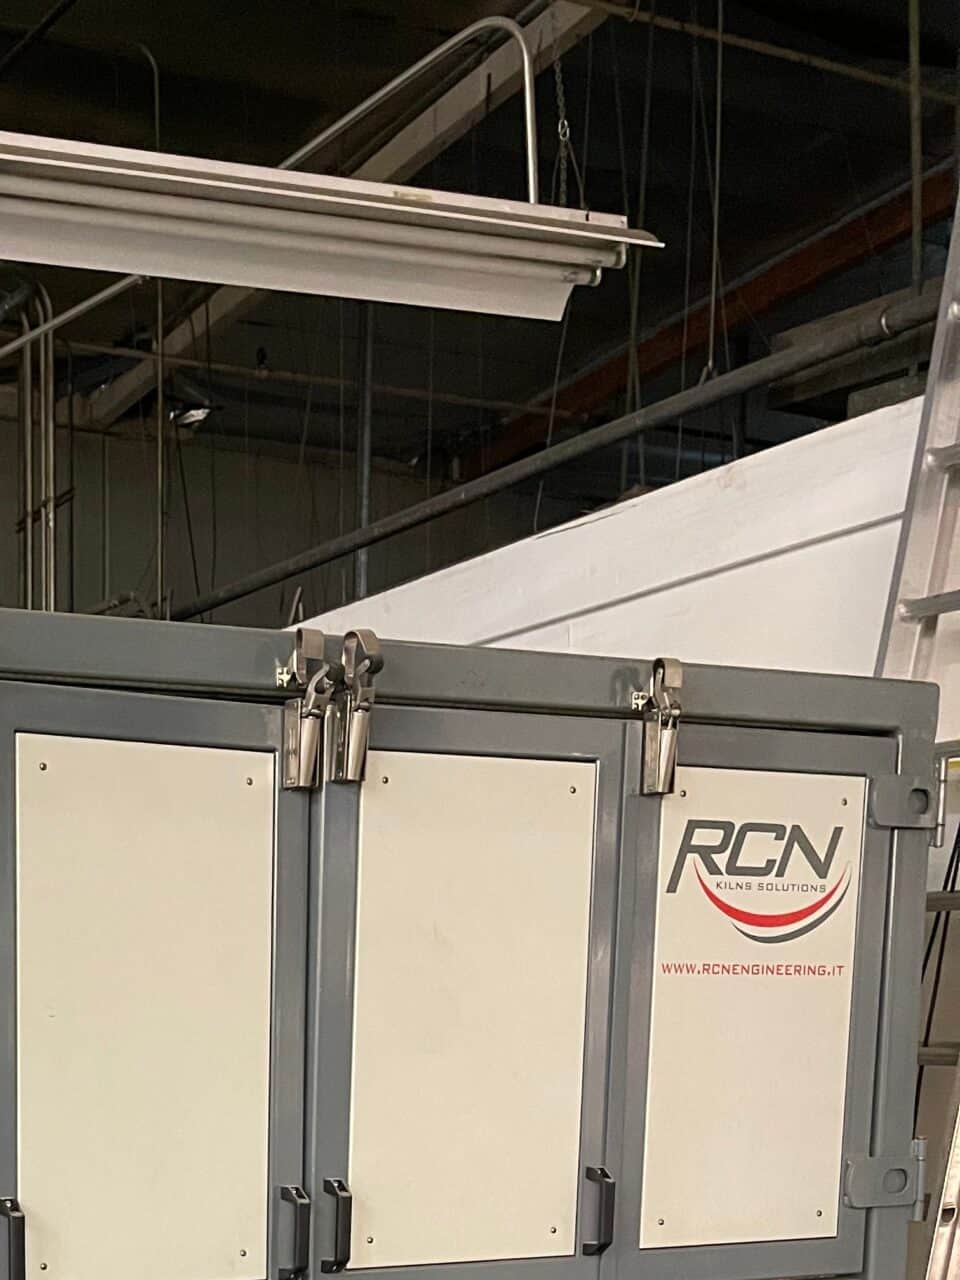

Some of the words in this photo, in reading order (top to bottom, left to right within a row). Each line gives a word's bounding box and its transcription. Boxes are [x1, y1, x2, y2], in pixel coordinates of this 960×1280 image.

[666, 819, 844, 894] RCN
[716, 880, 752, 891] KILNS
[757, 882, 827, 894] SOLUTIONS
[661, 962, 846, 977] WWW.RCNENGINEERING.IT
